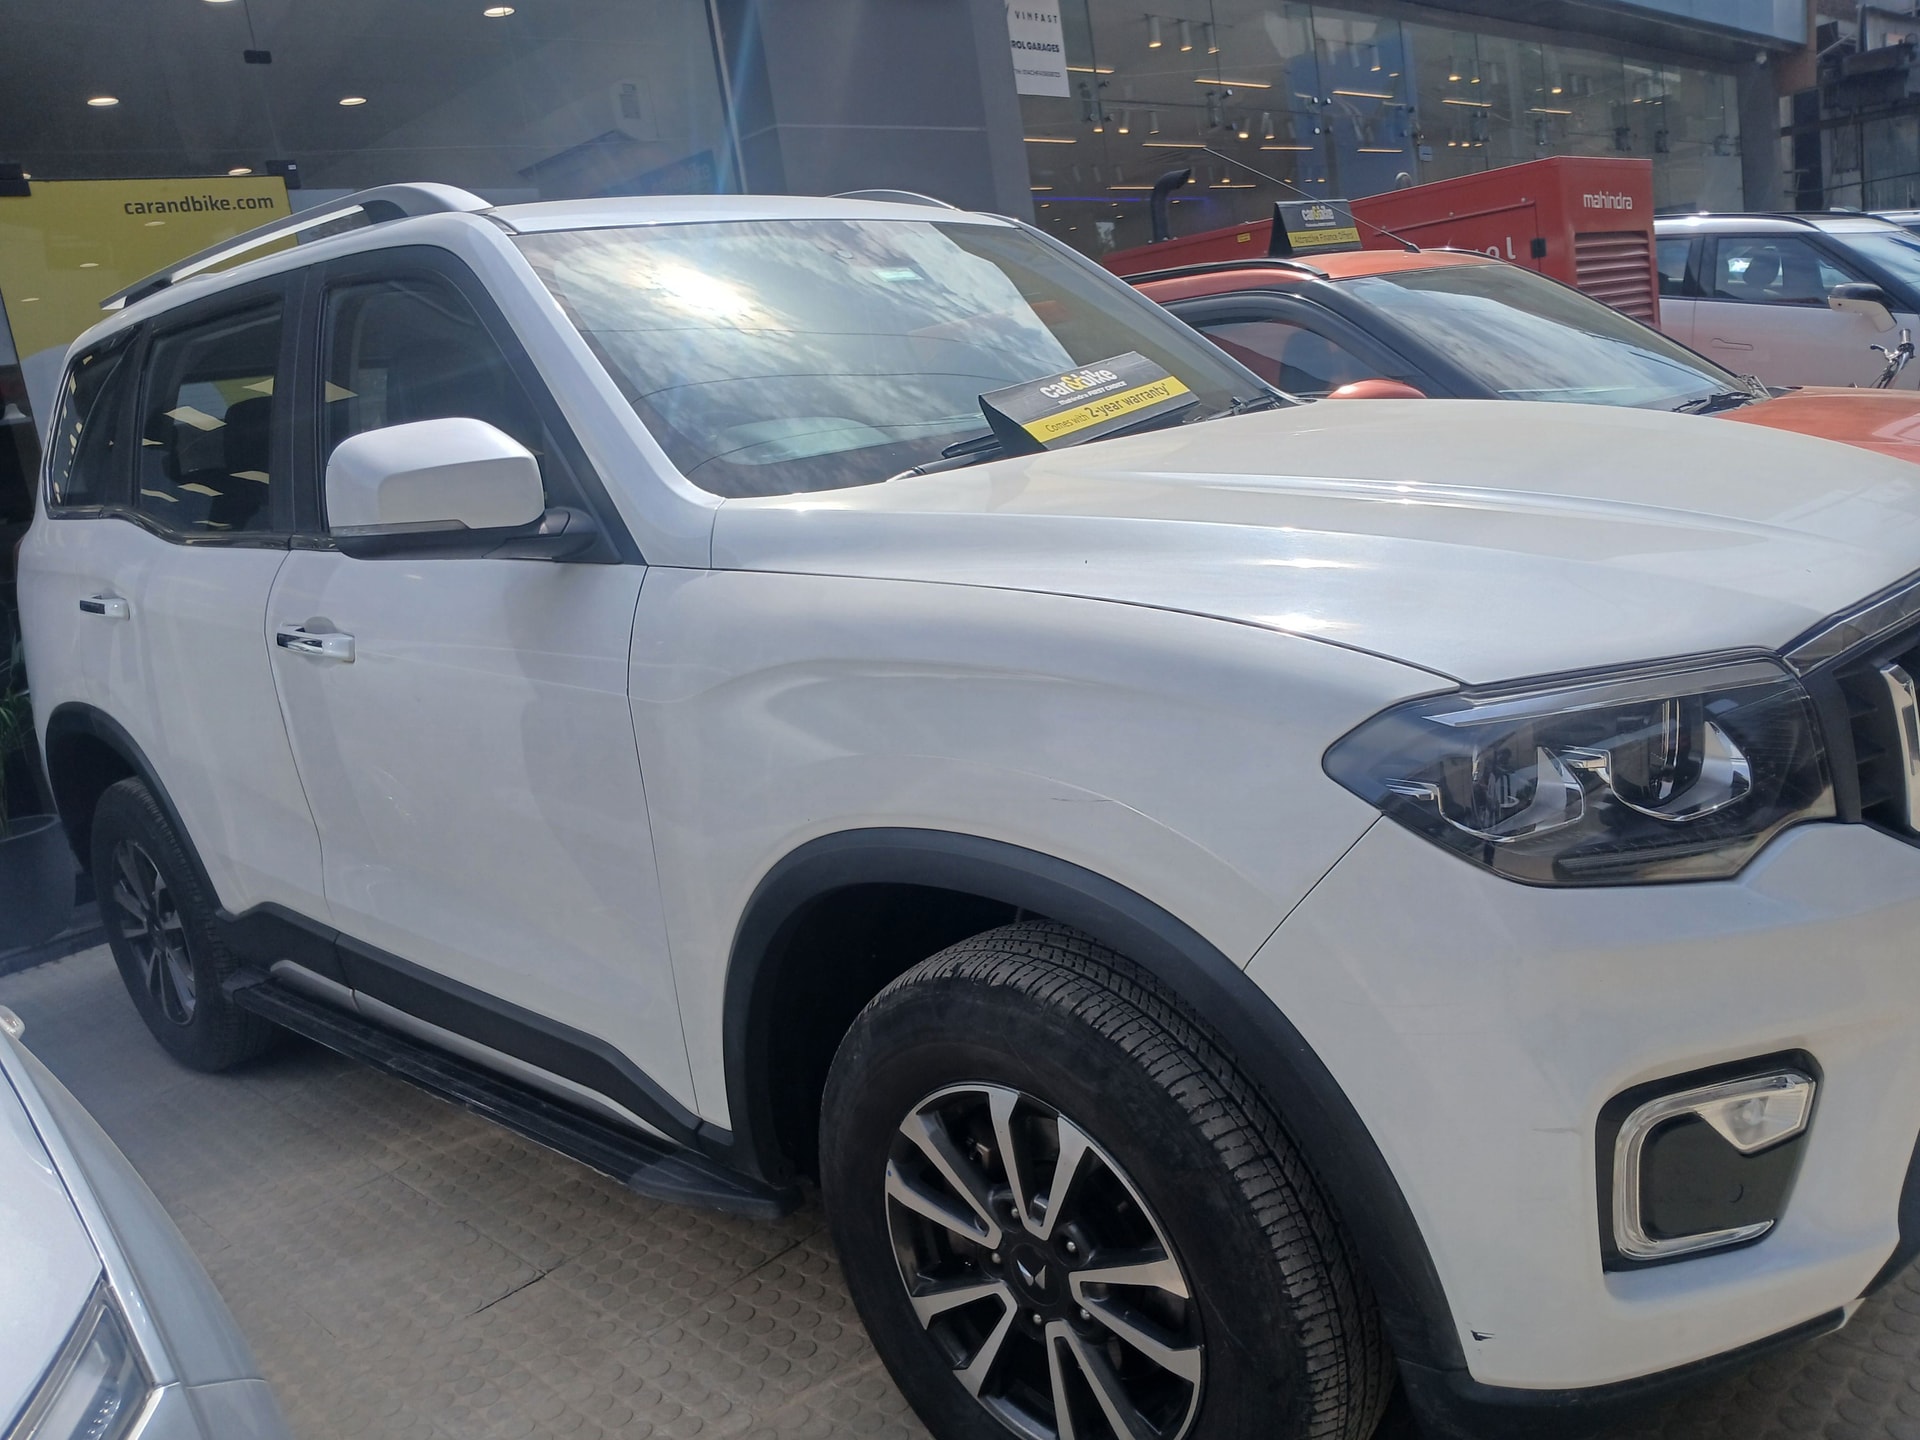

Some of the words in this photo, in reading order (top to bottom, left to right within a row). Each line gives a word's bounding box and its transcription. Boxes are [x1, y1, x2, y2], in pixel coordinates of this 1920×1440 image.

[1014, 10, 1058, 23] VINFAST
[1010, 40, 1026, 50] ROL
[124, 195, 274, 215] carandbike.com
[1583, 191, 1633, 210] mahindra
[1039, 368, 1118, 399] car&bike
[1045, 417, 1072, 433] Comes
[1072, 412, 1089, 425] with
[1084, 400, 1123, 417] 2-year
